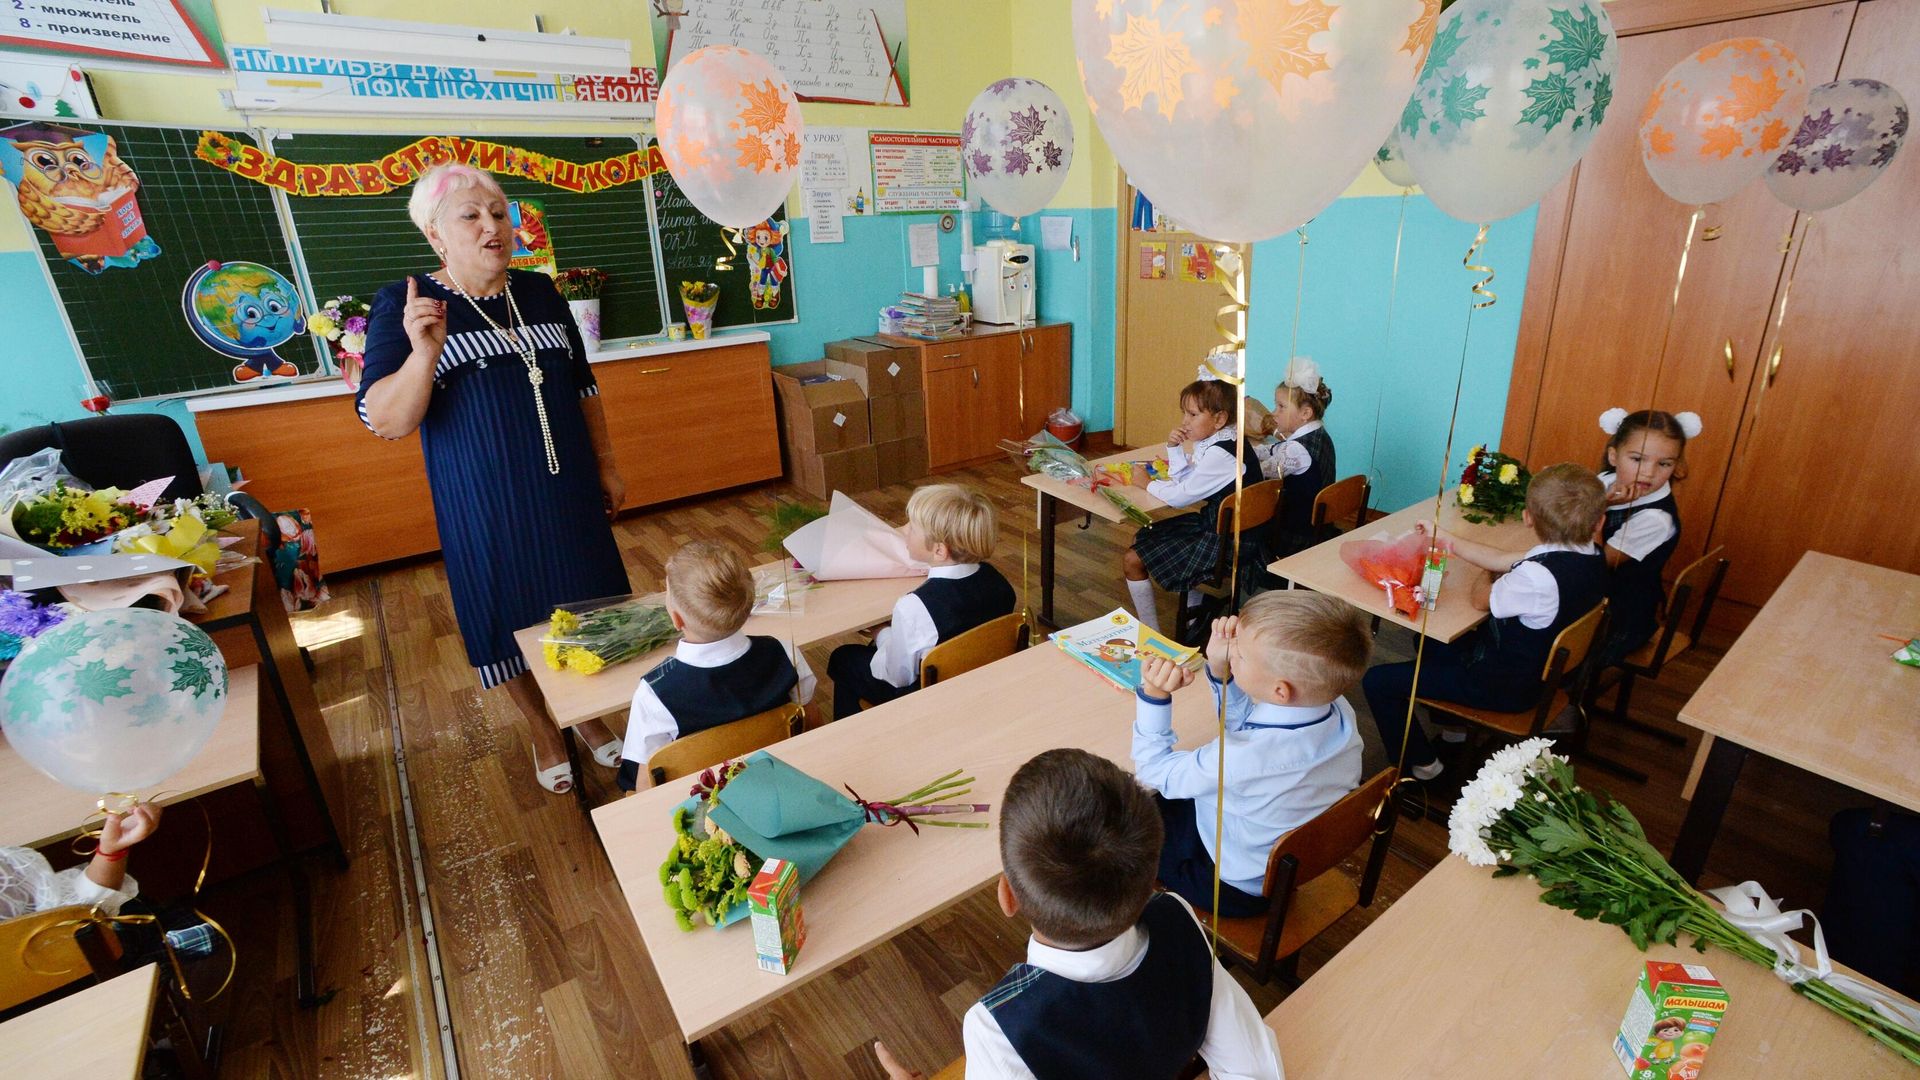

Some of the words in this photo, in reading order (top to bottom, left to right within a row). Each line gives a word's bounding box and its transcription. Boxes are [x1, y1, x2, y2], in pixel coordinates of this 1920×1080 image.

[14, 0, 25, 10] 2
[42, 5, 141, 24] множитель
[19, 17, 31, 29] 8
[48, 22, 171, 44] произведение
[813, 134, 842, 142] УРОКУ
[552, 146, 668, 192] ШКОЛА
[511, 256, 549, 267] НТЯБРЯ
[1076, 625, 1134, 647] Математика
